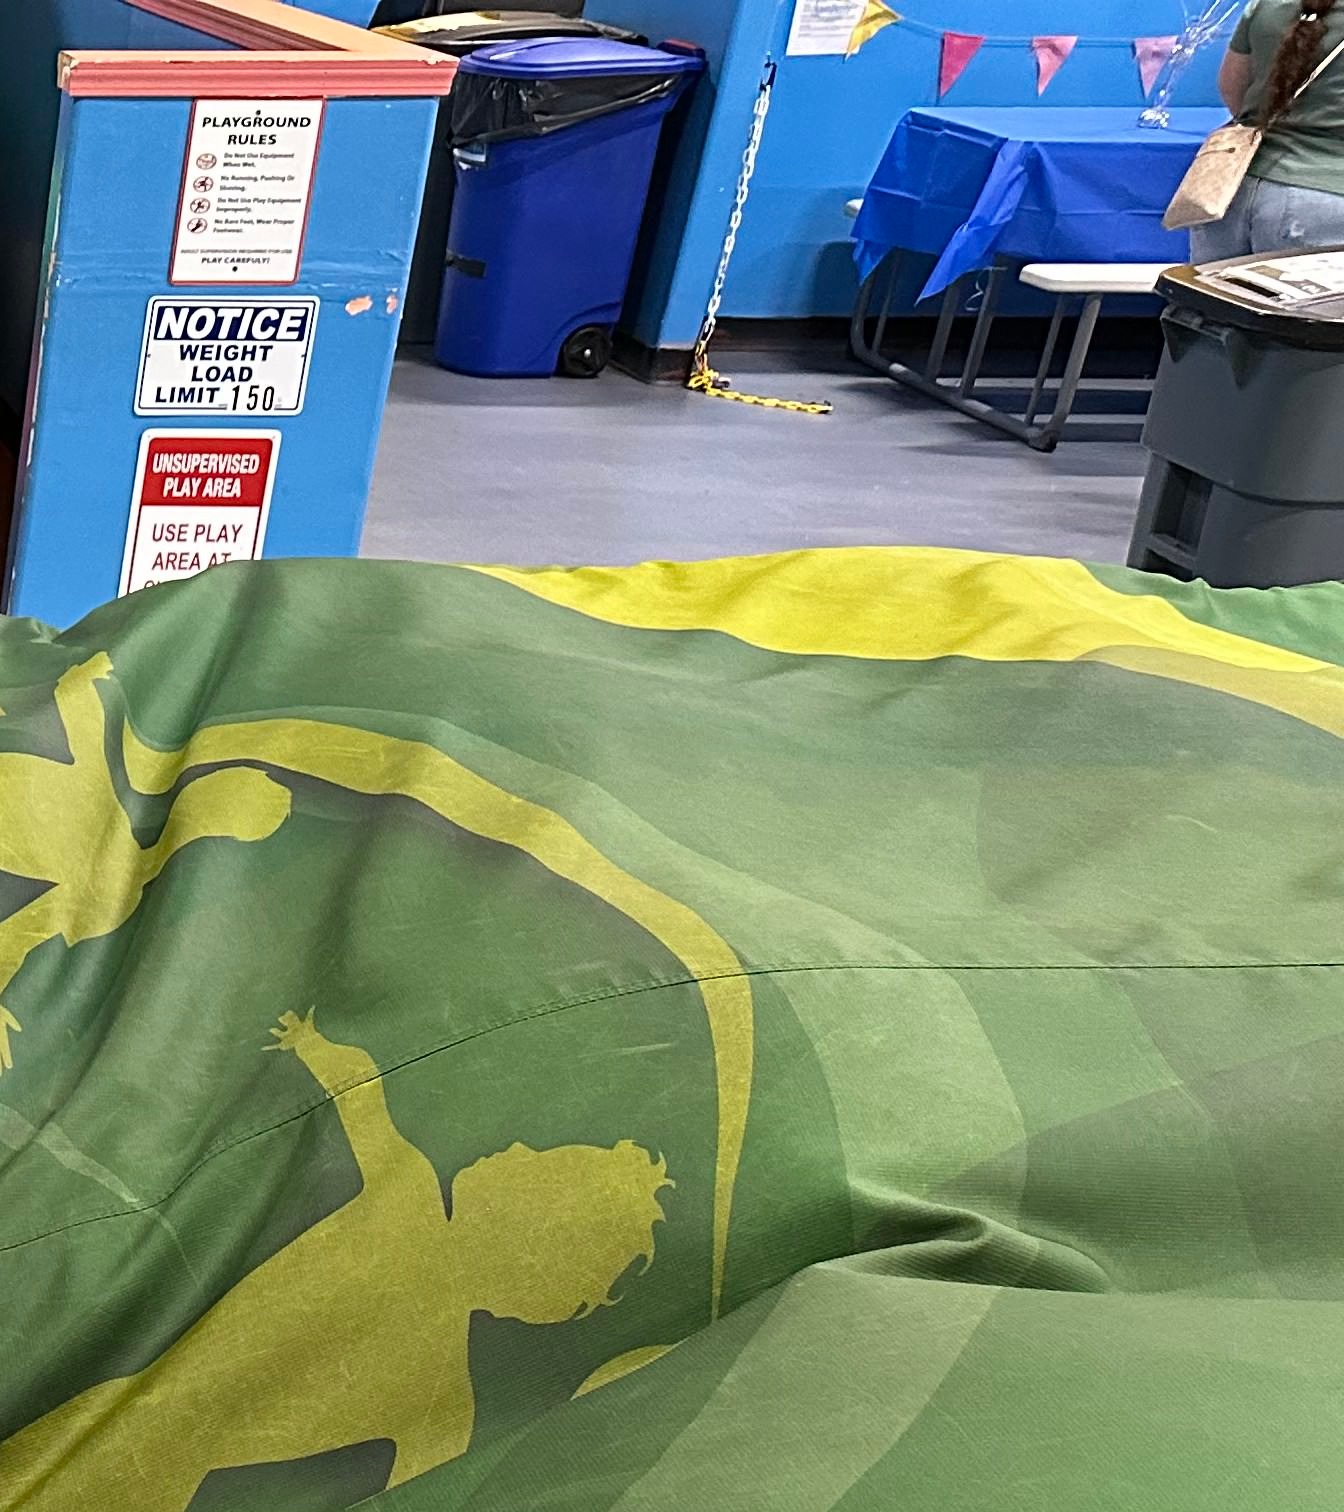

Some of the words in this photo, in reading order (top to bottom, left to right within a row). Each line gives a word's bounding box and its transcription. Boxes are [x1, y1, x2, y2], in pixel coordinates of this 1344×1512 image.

[202, 117, 311, 128] PLAYGROUND
[227, 134, 277, 145] RULES
[156, 308, 306, 340] NOTICE
[179, 344, 273, 361] WEIGHT
[191, 366, 253, 382] LOAD
[155, 387, 220, 403] LIMIT
[231, 385, 275, 411] 150
[152, 453, 260, 474] UNSUPERVISED
[163, 477, 202, 497] PLAY
[202, 478, 241, 497] AREA
[152, 523, 189, 542] USE
[193, 523, 243, 543] PLAY
[151, 552, 201, 570] AREA
